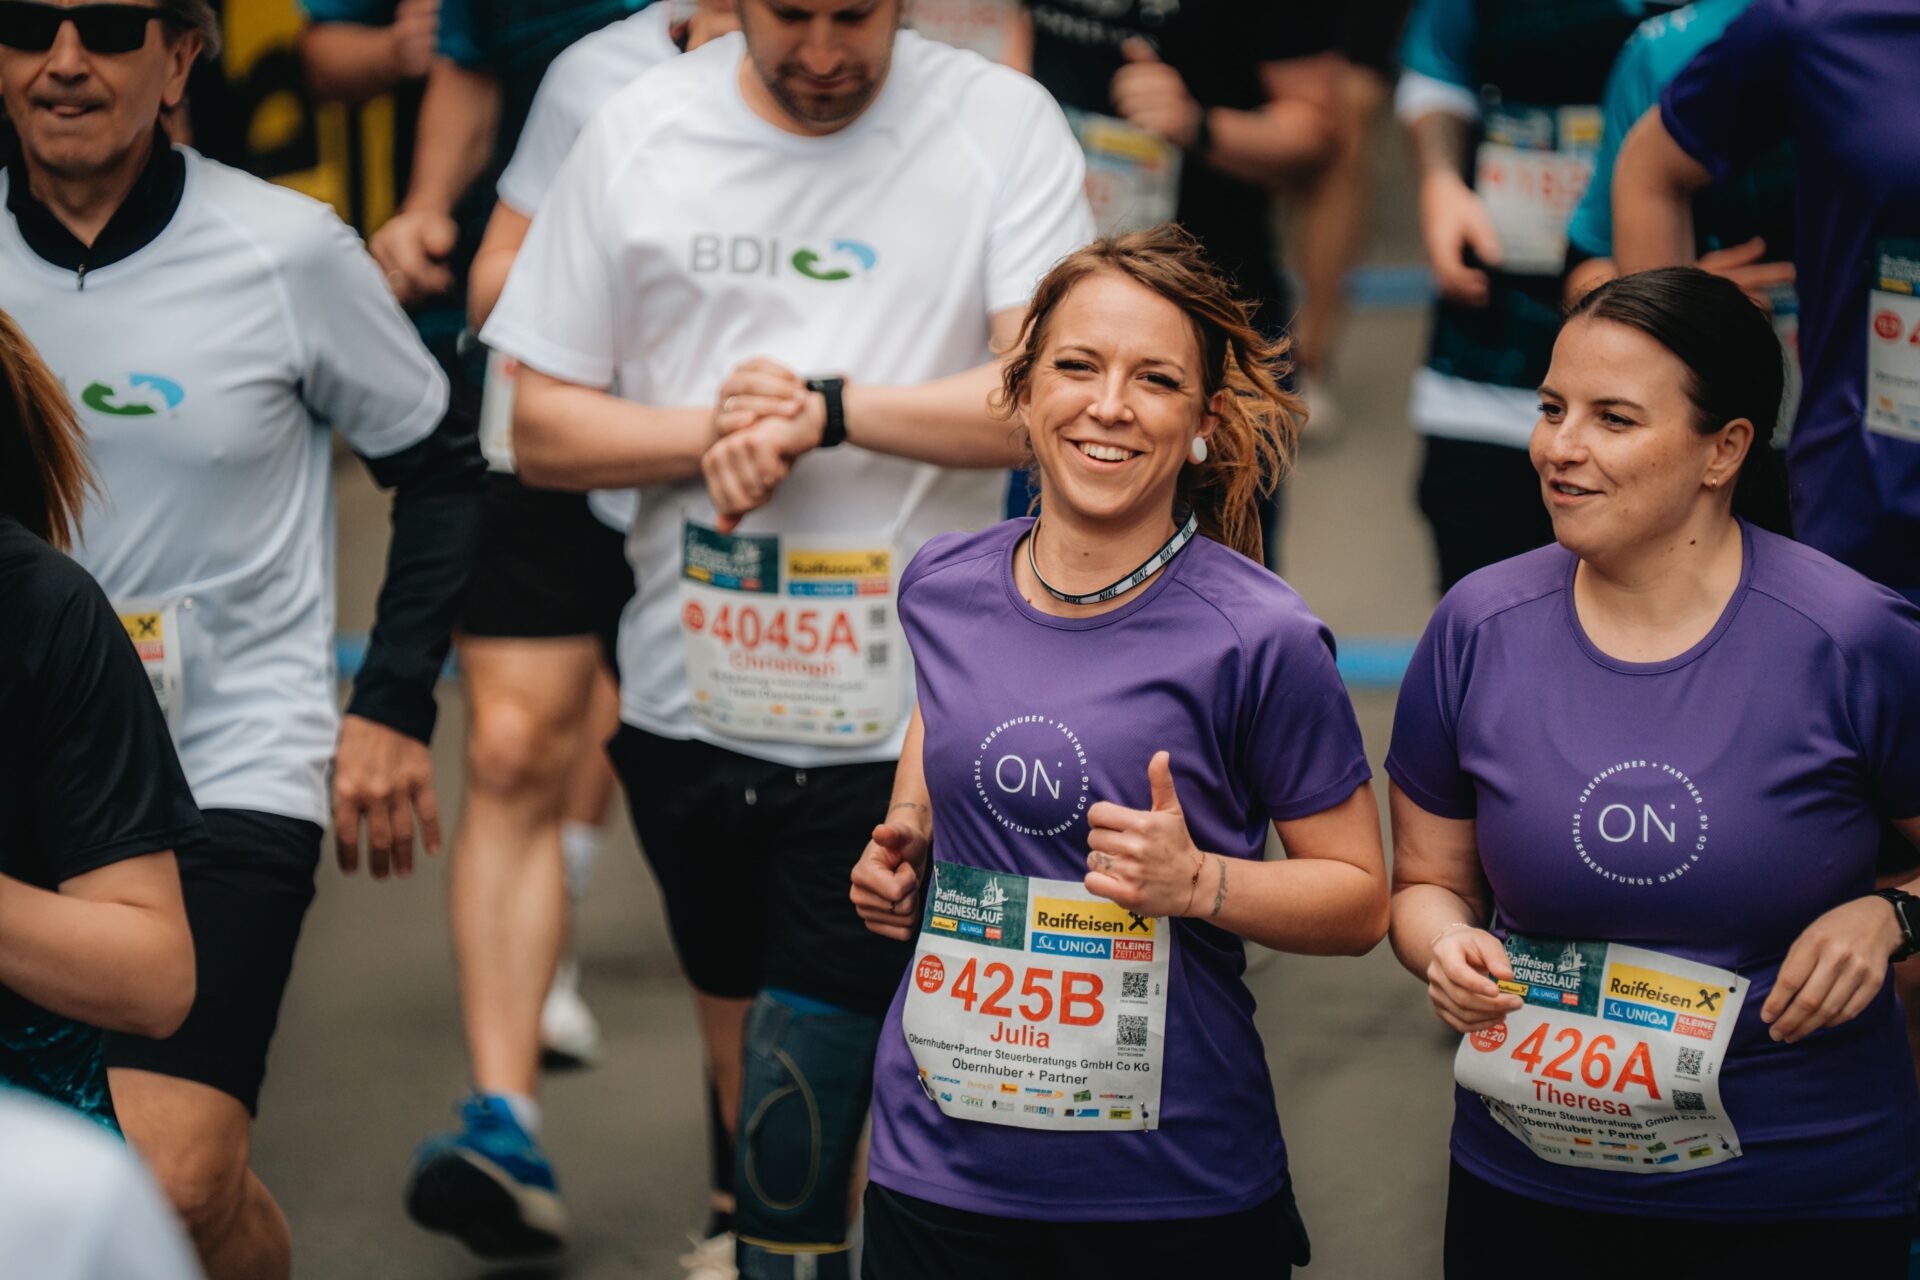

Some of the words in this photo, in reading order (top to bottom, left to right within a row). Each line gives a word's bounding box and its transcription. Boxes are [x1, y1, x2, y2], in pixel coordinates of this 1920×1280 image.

[691, 234, 778, 277] BDI
[1099, 586, 1118, 602] NIKE
[1131, 566, 1149, 587] NIKE
[1159, 542, 1175, 564] NIKE
[711, 604, 860, 655] 4045A
[980, 715, 1045, 750] OBERNHUBER
[1056, 722, 1087, 765] PARTNER
[1579, 760, 1646, 803] OBERNHUBER
[1662, 764, 1703, 805] PARTNER
[974, 760, 1044, 836] STEUERBERATUNGS
[1077, 796, 1087, 810] CO
[1572, 813, 1653, 886] STEUERBERATUNGS
[1696, 834, 1707, 851] CO
[935, 888, 978, 907] Raiffeisen
[934, 900, 1004, 925] BUSINESSLAUF
[1037, 911, 1124, 933] Raiffeisen
[1059, 939, 1106, 955] UNIQA
[1114, 949, 1152, 960] ZEITUNG
[1115, 942, 1152, 951] KLEINE
[919, 966, 944, 981] 18:20
[1512, 966, 1581, 990] SINESSLAUF
[950, 957, 1105, 1027] 425B
[1610, 977, 1692, 1009] Raiffeisen
[1626, 1007, 1668, 1027] UNIQA
[1678, 1015, 1715, 1031] KLEINE
[990, 1021, 1050, 1049] Julia
[1676, 1026, 1712, 1039] ZEITUNG
[908, 1033, 992, 1057] Obernhuber+Partner
[995, 1049, 1077, 1070] Steuerberatungs
[1080, 1059, 1113, 1070] GmbH
[1116, 1061, 1131, 1071] Co
[1133, 1062, 1150, 1072] KG
[1510, 1022, 1662, 1100] 426A
[952, 1057, 1024, 1078] Obernhuber
[1039, 1070, 1088, 1085] Partner
[1532, 1079, 1633, 1117] Theresa
[1518, 1115, 1593, 1135] Obernhuber
[1608, 1129, 1657, 1141] Partner
[1559, 1111, 1643, 1130] Steuerberatungs
[1645, 1114, 1679, 1128] GmbH
